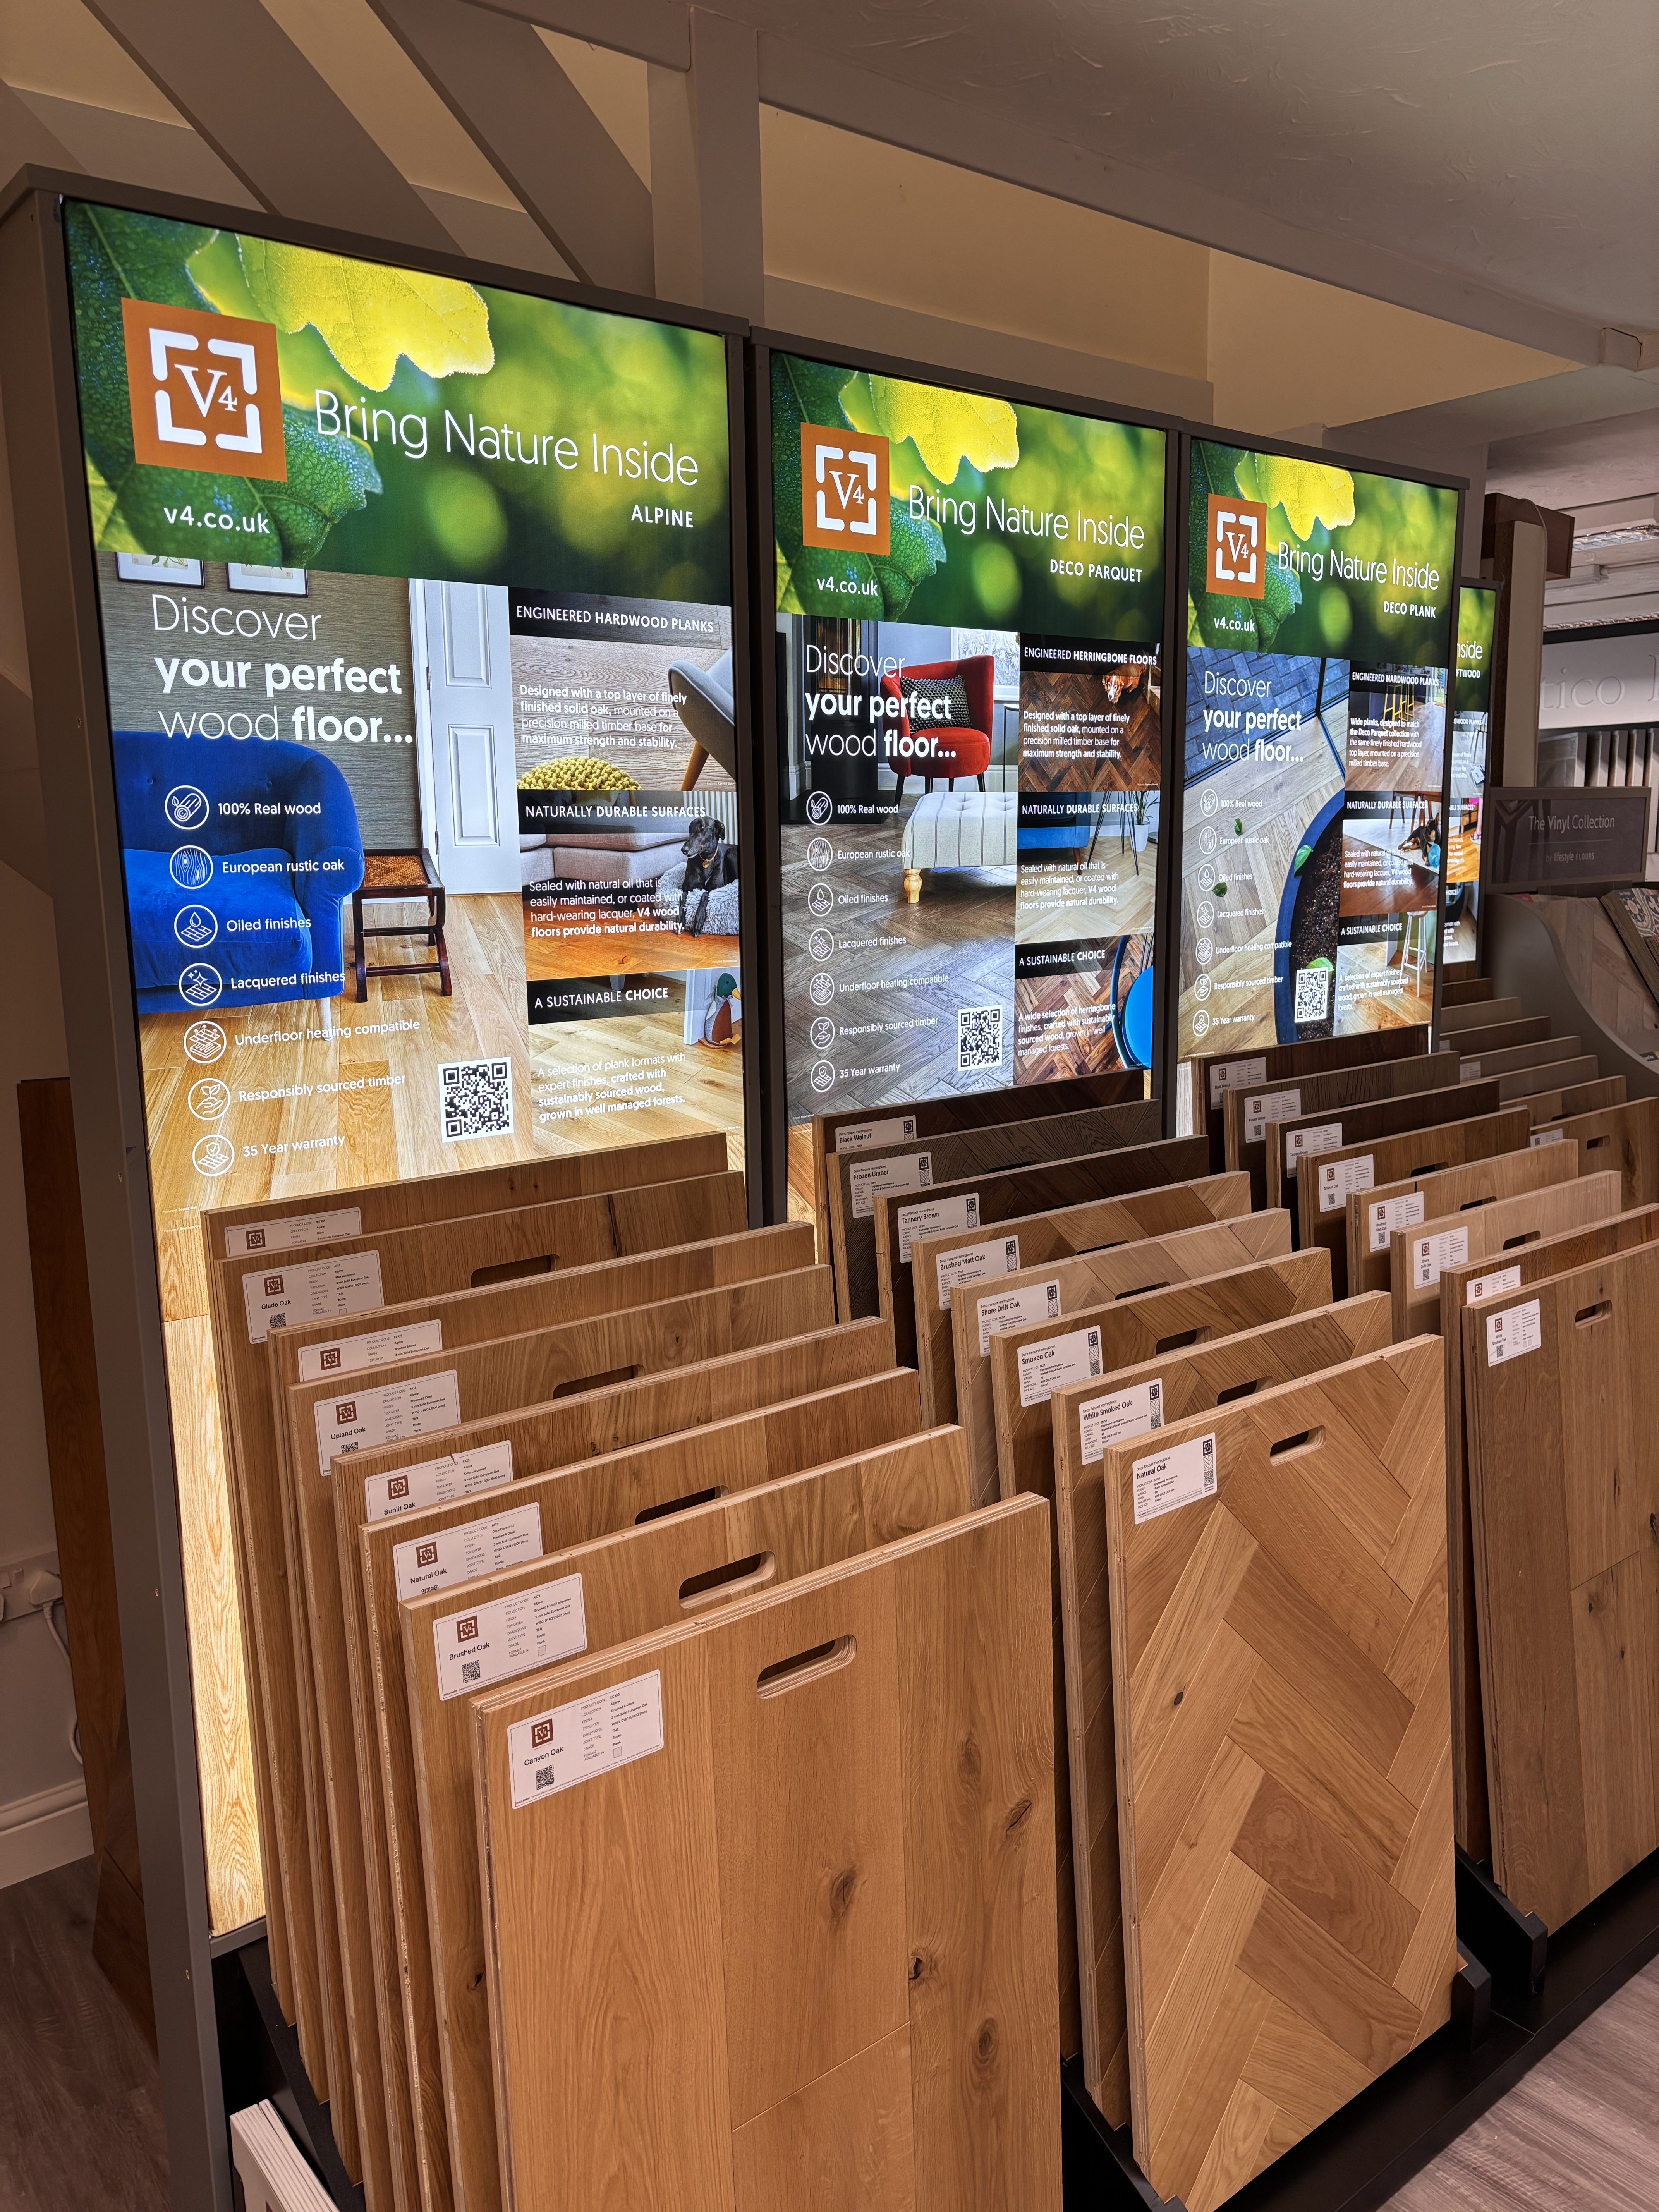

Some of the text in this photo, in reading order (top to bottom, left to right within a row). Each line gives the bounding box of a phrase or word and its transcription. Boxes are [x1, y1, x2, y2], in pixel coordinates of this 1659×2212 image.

[174, 363, 238, 419] V4
[314, 388, 699, 487] Bring Nature Inside
[828, 470, 865, 510] V4
[163, 505, 270, 536] v4.co.uk
[631, 503, 694, 529] ALPINE
[909, 484, 1145, 550] Bring Nature Inside
[1225, 532, 1249, 563] V4
[1050, 558, 1142, 583] DECO PARQUET
[1278, 541, 1439, 591] Bring Nature Inside
[817, 576, 878, 596] v4.co.uk
[152, 594, 322, 641] Discover
[516, 605, 714, 632] ENGINEERED HARDWOOD PLANKS
[1383, 601, 1436, 618] DECO PLANK
[1214, 617, 1255, 632] v4.co.uk
[807, 644, 905, 678] Discover
[1024, 647, 1157, 665] ENGINEERED HERRINGBONE FLOORS
[154, 657, 402, 698] your perfect
[1204, 671, 1272, 697] Discover
[1352, 672, 1439, 686] ENGINEERED HARDWOOD PLANKS
[520, 685, 568, 699] Designed
[571, 687, 593, 699] with
[603, 690, 621, 702] top
[623, 689, 647, 703] layer
[649, 691, 659, 702] of
[661, 692, 687, 705] finely
[520, 701, 561, 713] finished
[563, 702, 588, 714] solid
[590, 705, 612, 716] oak,
[613, 706, 656, 717] mounted
[658, 709, 671, 718] on
[805, 690, 951, 723] your perfect
[158, 705, 413, 744] wood floor...
[1203, 708, 1302, 734] your perfect
[805, 728, 956, 758] wood floor...
[1202, 738, 1304, 763] wood floor...
[217, 802, 321, 815] 100% Real wood
[526, 805, 706, 817] NATURALLY DURABLE SURFACES
[837, 804, 898, 814] 100% Real wood
[1022, 804, 1138, 815] NATURALLY DURABLE SURFACES
[1347, 801, 1376, 809] NATURALLY
[1402, 800, 1428, 809] SURFACES
[1529, 814, 1615, 833] The Vinyl Collection
[838, 849, 911, 860] European rustic oak
[1554, 852, 1573, 863] lifestyle
[1575, 852, 1594, 860] FLOORS
[222, 859, 345, 875] European rustic oak
[838, 893, 888, 905] Oiled finishes
[226, 917, 312, 932] Oiled finishes
[1341, 923, 1402, 936] A SUSTAINABLE CHOICE
[838, 935, 907, 950] Lacquered finishes
[1019, 950, 1105, 967] A SUSTAINABLE CHOICE
[230, 971, 346, 991] Lacquered finishes
[839, 974, 949, 993] Underfloor heating compatible
[534, 988, 668, 1009] A SUSTAINABLE CHOICE
[235, 1019, 421, 1046] Underfloor heating compatible
[839, 1017, 938, 1036] Responsibly sourced timber
[840, 1062, 900, 1079] 35 Year warranty
[239, 1074, 406, 1103] Responsibly sourced timber
[242, 1137, 346, 1158] 35 Year warranty
[854, 1169, 889, 1180] Frozen Umber
[923, 1212, 939, 1220] Brown
[940, 1260, 961, 1271] Brushed
[962, 1257, 974, 1266] Matt
[261, 1302, 278, 1310] Glade
[981, 1307, 996, 1316] Shore
[998, 1304, 1009, 1312] Drift
[1022, 1355, 1043, 1365] Smoked
[1083, 1400, 1132, 1421] White Smoked Oak
[331, 1430, 352, 1440] Upland
[1137, 1463, 1167, 1480] Natural Oak
[384, 1502, 416, 1515] Sunlit Oak
[410, 1568, 447, 1584] Natural Oak
[449, 1642, 490, 1660] Brushed Oak
[524, 1746, 563, 1766] Canyon Oak
